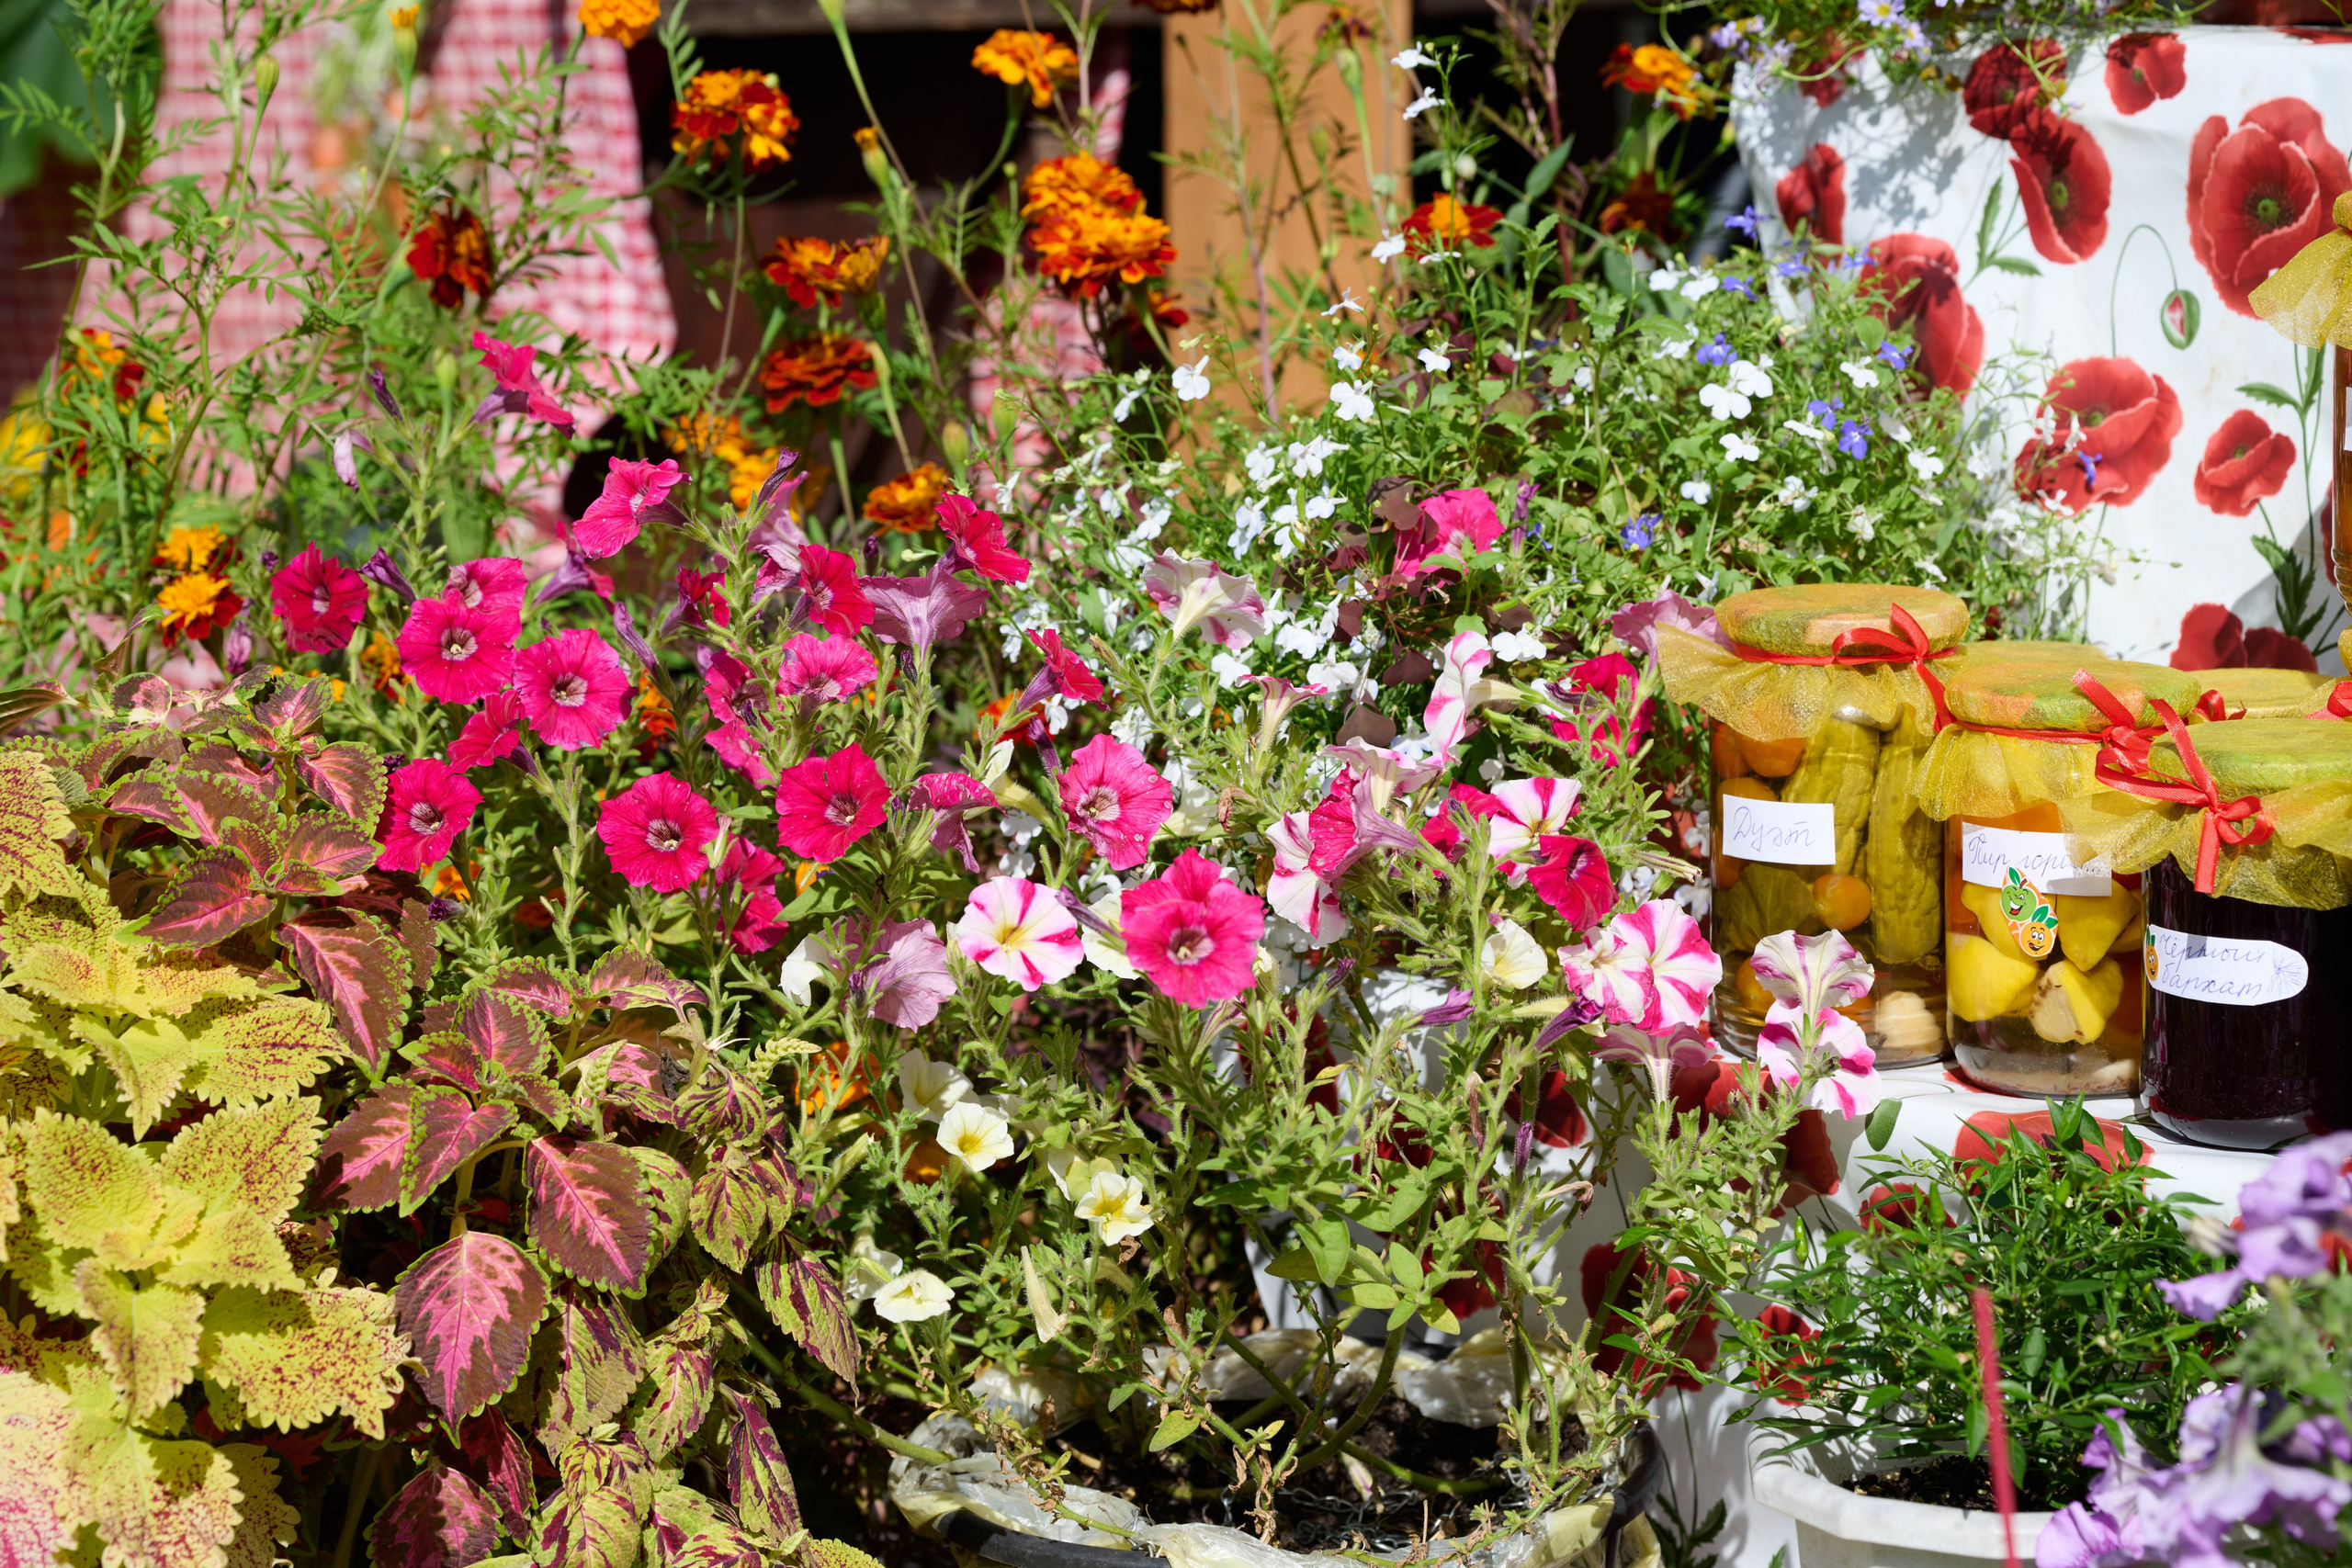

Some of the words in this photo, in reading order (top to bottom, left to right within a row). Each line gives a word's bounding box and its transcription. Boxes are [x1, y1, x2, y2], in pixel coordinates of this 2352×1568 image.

[1733, 806, 1815, 852] Дуэт
[1968, 833, 2011, 874] Пир
[2161, 962, 2262, 999] бархат
